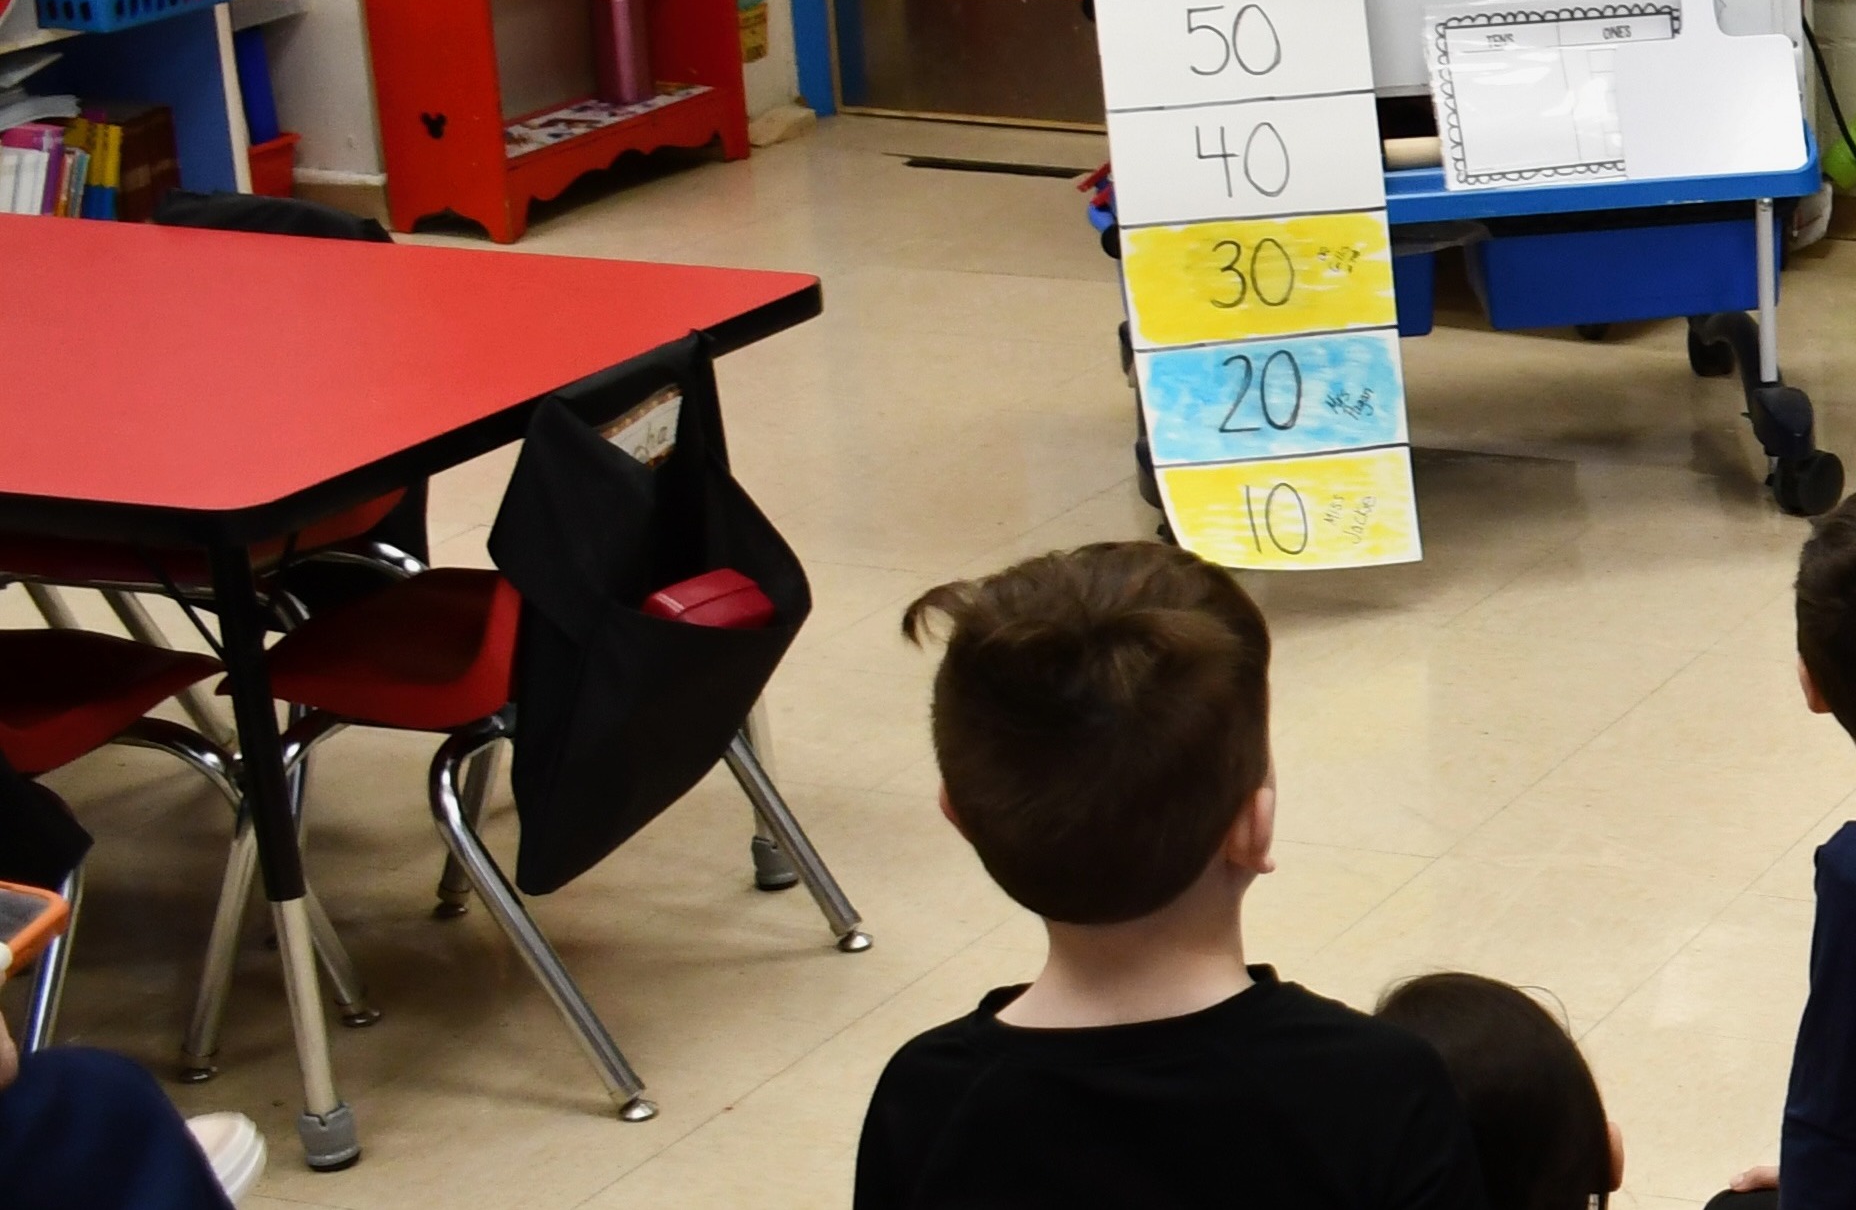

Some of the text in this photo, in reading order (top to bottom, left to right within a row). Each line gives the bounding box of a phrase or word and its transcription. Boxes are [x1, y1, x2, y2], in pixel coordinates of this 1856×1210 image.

[1186, 4, 1280, 76] 50
[1603, 25, 1631, 40] ONES
[1196, 122, 1289, 197] 40
[1210, 238, 1294, 308] 30
[1219, 350, 1301, 433] 20
[1244, 482, 1307, 555] 10
